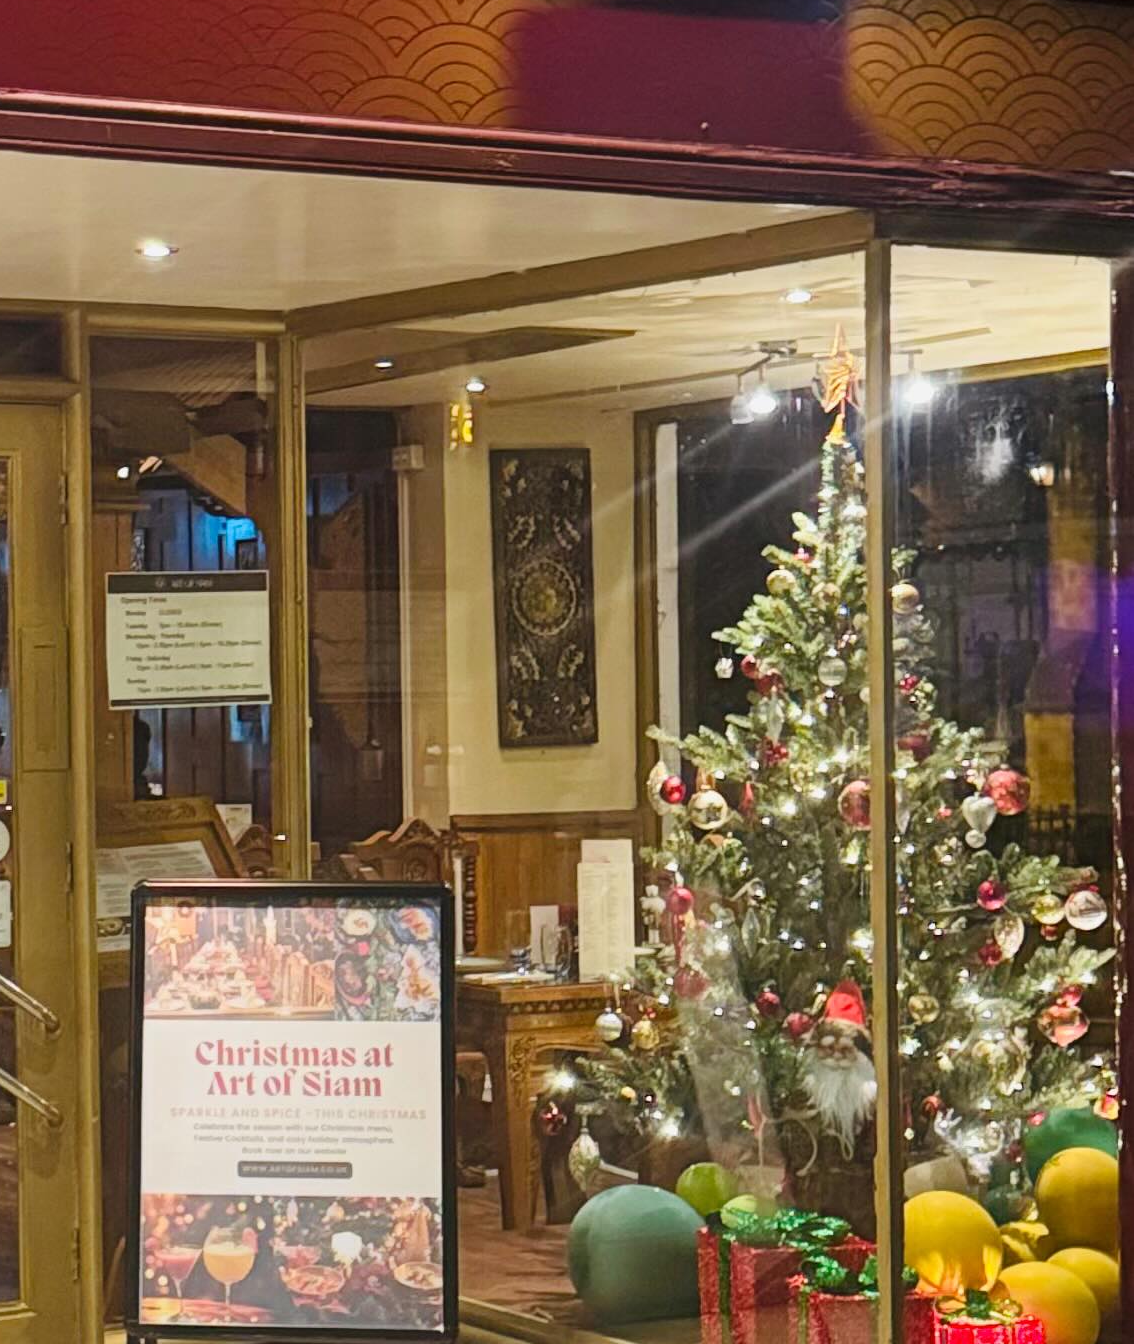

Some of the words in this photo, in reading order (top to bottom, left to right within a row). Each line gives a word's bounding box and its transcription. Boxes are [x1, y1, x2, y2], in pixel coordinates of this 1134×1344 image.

[195, 1039, 357, 1068] Christmas
[363, 1044, 395, 1068] at
[206, 1070, 257, 1097] Art
[263, 1068, 298, 1097] of
[302, 1070, 383, 1098] Siam
[170, 1107, 226, 1119] SPARKLE
[231, 1107, 260, 1119] AND
[263, 1107, 301, 1120] SPICE
[348, 1108, 427, 1121] CHRISTMAS
